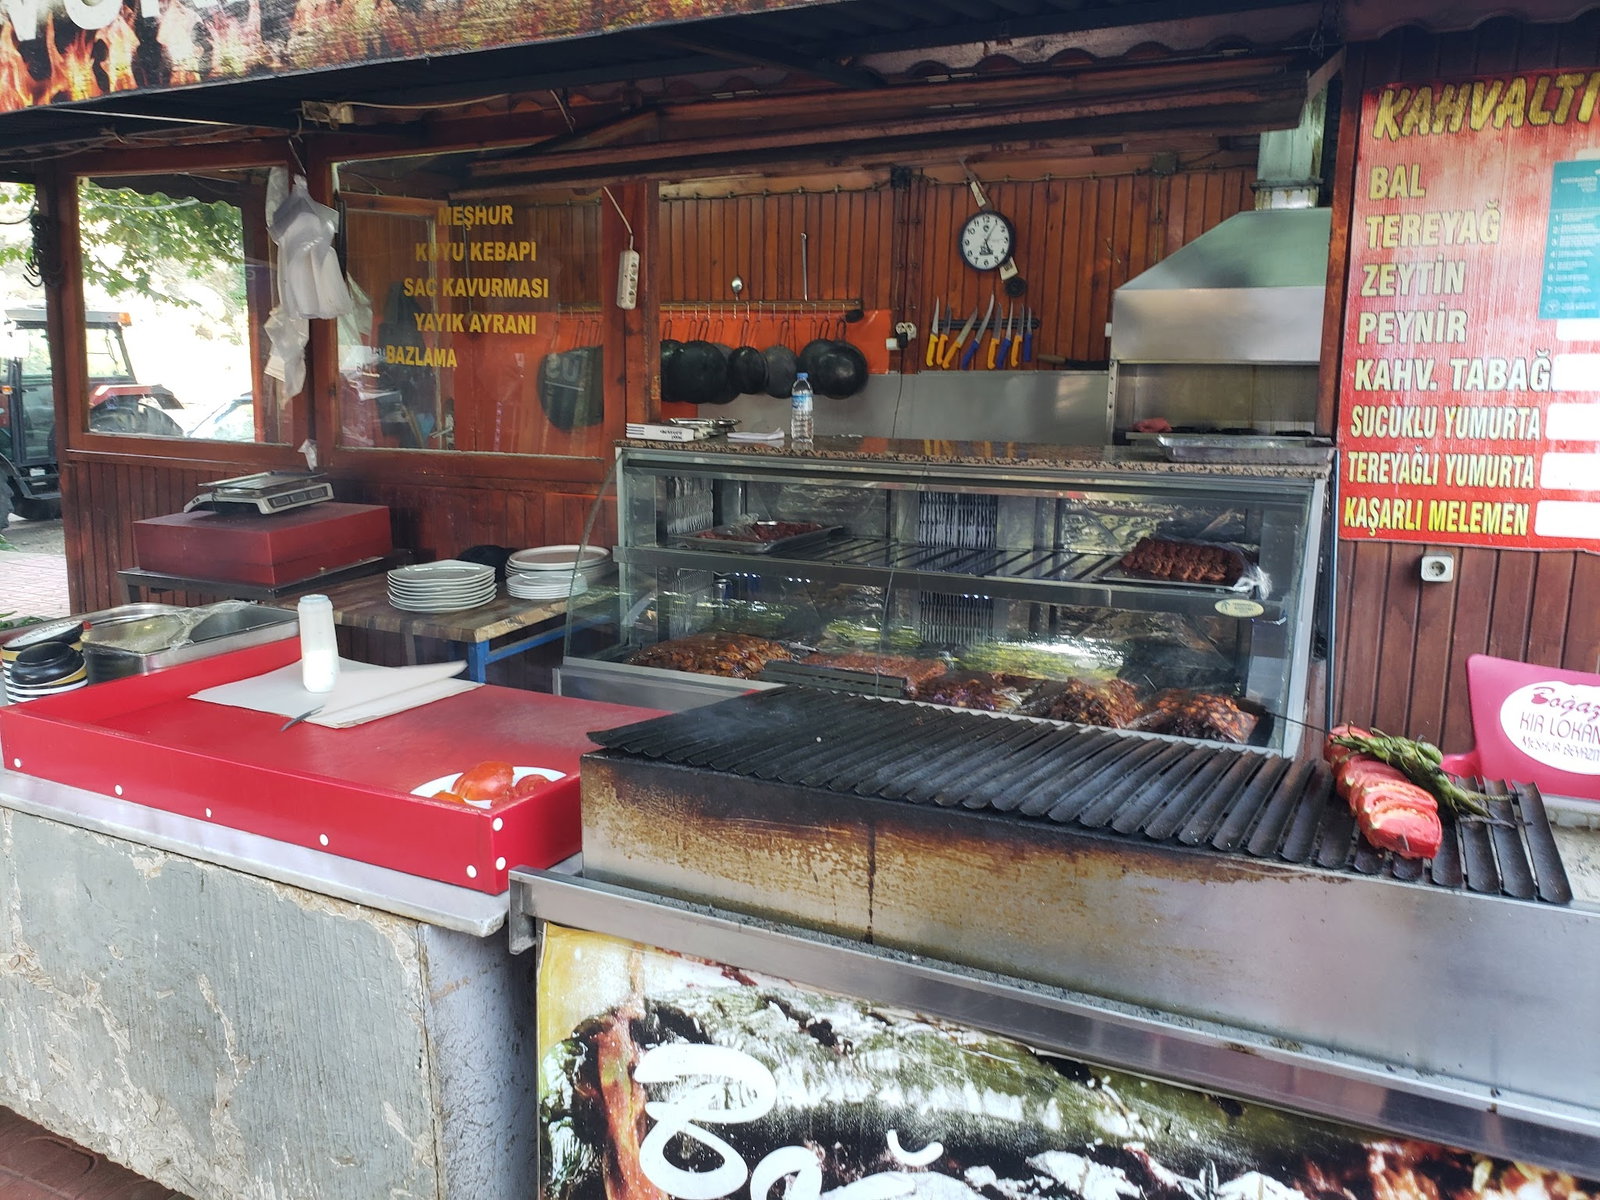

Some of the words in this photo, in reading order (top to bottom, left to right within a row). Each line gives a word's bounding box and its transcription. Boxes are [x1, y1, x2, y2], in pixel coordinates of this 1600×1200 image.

[1373, 72, 1600, 141] KAHVALTI
[1369, 164, 1426, 201] BAL
[438, 204, 514, 231] MEŞHUR
[1366, 198, 1502, 249] TEREYAĞ
[470, 241, 537, 262] KEBAPI
[403, 277, 437, 297] SAC
[442, 277, 549, 298] KAVURMASI
[1360, 253, 1466, 296] ZEYTİN
[414, 312, 465, 332] YAYIK
[469, 313, 537, 335] AYRANI
[1357, 301, 1468, 345] PEYNİR
[385, 345, 458, 368] BAZLAMA
[1354, 357, 1438, 392] KAHV.
[1350, 404, 1438, 439] SUCUKLU
[1444, 406, 1542, 442] YUMURTA
[1348, 444, 1440, 485] TEREYAĞLI
[1445, 453, 1535, 489] YUMURTA
[1344, 496, 1423, 537] KAŞARLI
[1428, 499, 1530, 536] MELEMEN
[1520, 711, 1544, 733] KIR
